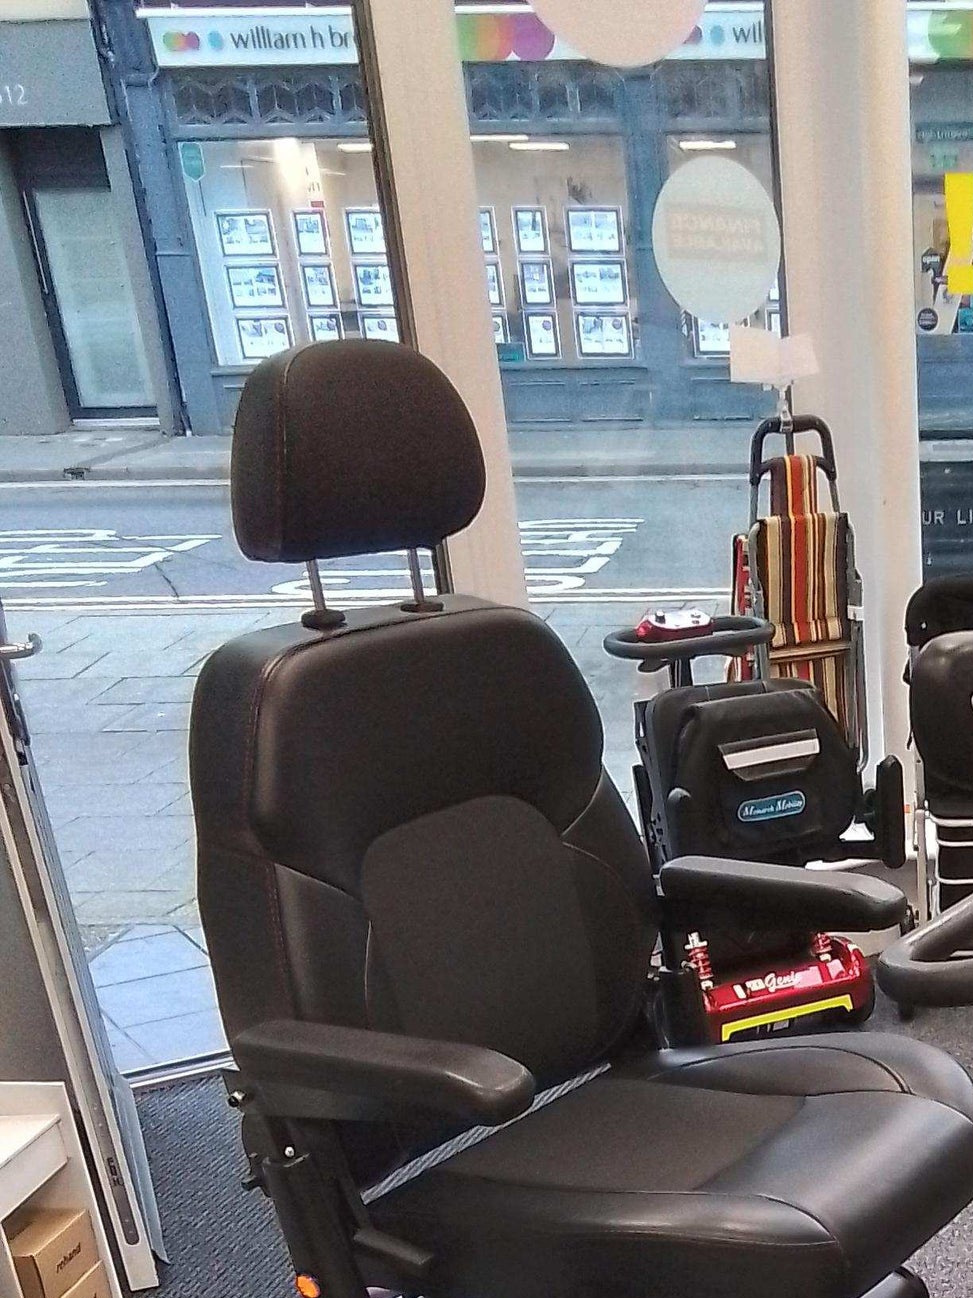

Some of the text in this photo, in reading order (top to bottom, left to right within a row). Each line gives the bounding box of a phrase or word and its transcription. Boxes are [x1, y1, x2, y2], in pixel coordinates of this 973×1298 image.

[230, 25, 306, 49] william
[310, 25, 325, 49] h
[0, 84, 28, 105] 12
